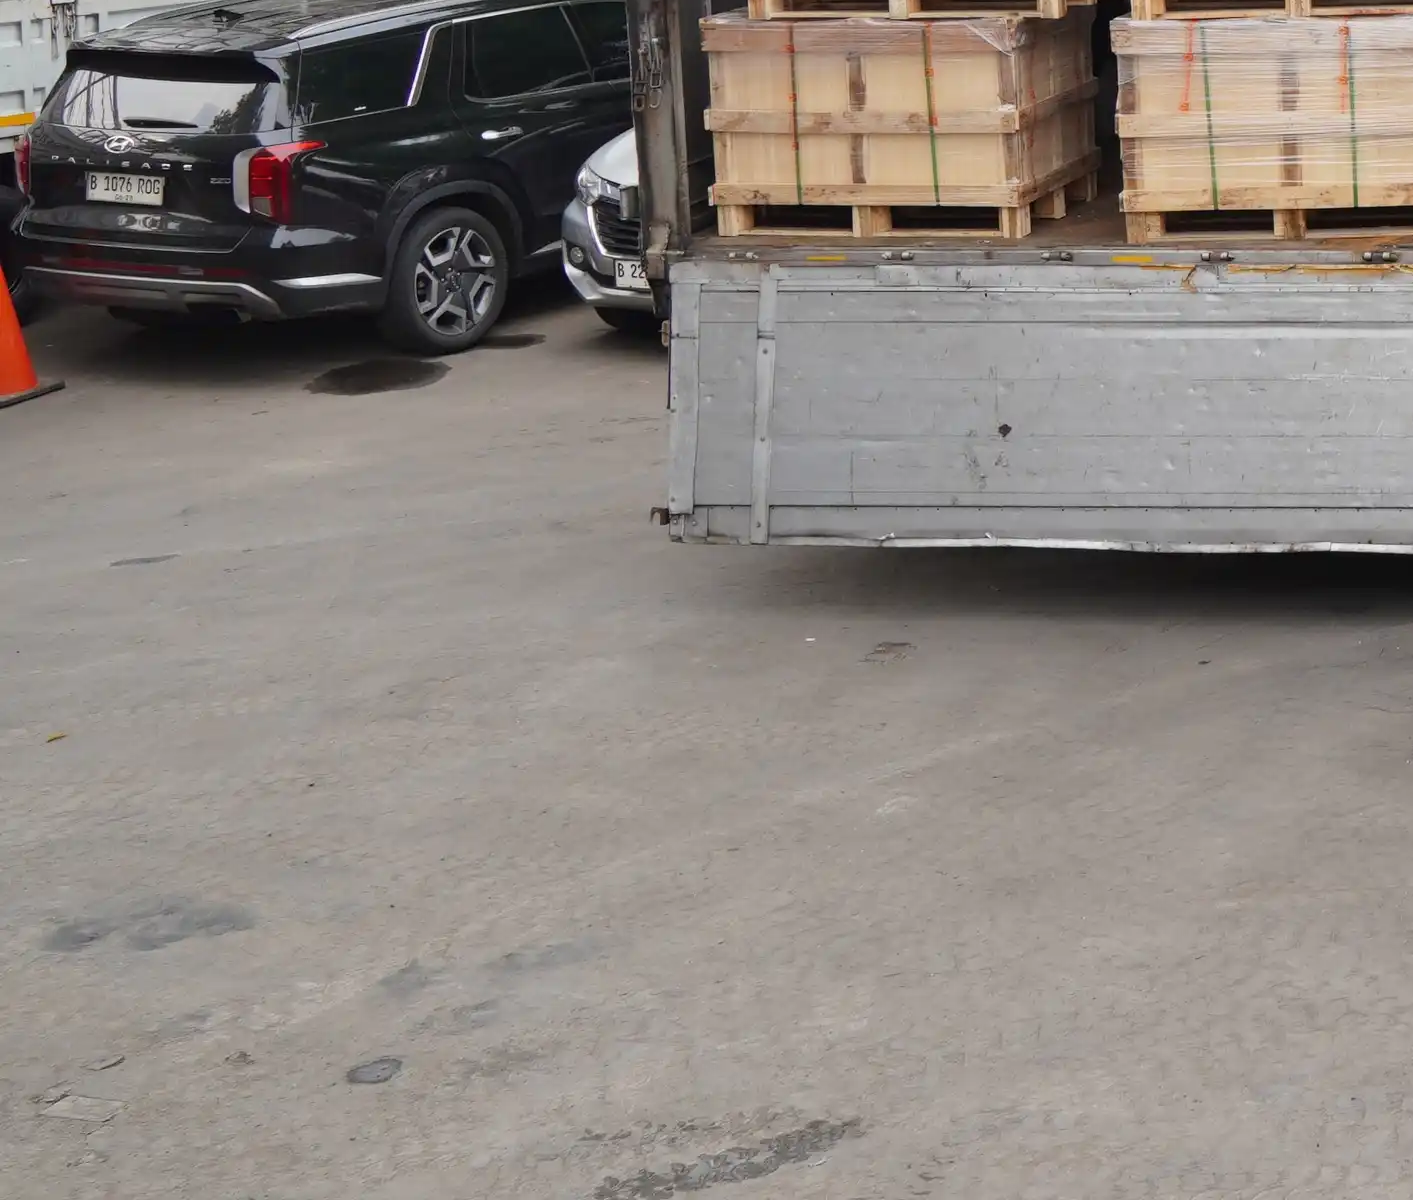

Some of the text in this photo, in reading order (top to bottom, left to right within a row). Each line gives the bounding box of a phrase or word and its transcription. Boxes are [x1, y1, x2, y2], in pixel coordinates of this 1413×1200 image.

[51, 154, 193, 172] PALISADE
[90, 175, 98, 191] B
[103, 175, 133, 193] 1076
[618, 263, 624, 277] B
